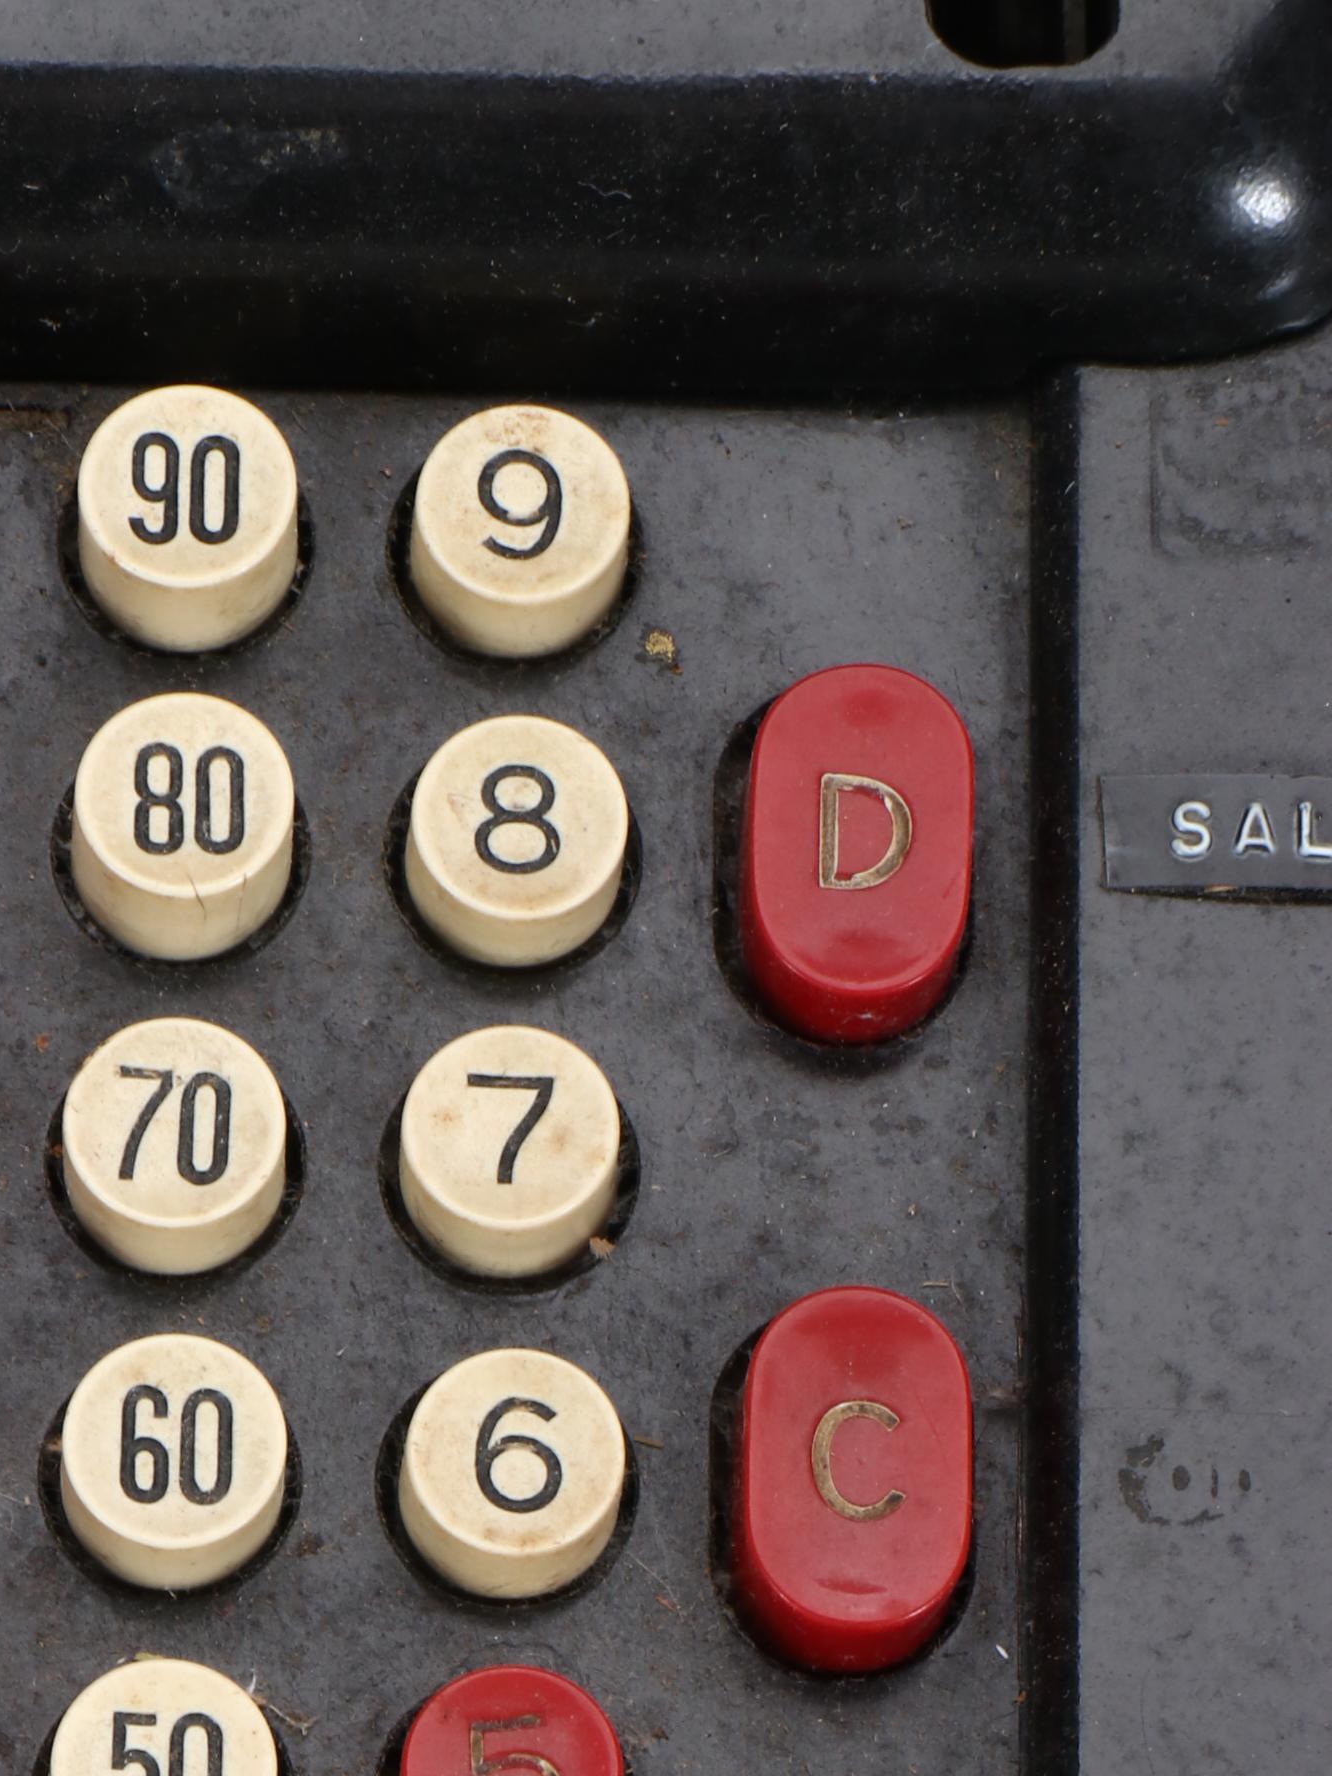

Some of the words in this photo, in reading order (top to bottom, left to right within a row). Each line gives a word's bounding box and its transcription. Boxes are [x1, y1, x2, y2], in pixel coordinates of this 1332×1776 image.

[129, 431, 241, 545] 90
[477, 449, 563, 559] 9
[133, 741, 244, 855] 80
[474, 764, 560, 873] 8
[819, 773, 912, 890] D
[1171, 800, 1332, 859] SAL
[118, 1065, 232, 1186] 70
[467, 1073, 555, 1185] 7
[120, 1384, 233, 1506] 60
[475, 1396, 563, 1514] 6
[811, 1400, 906, 1522] C
